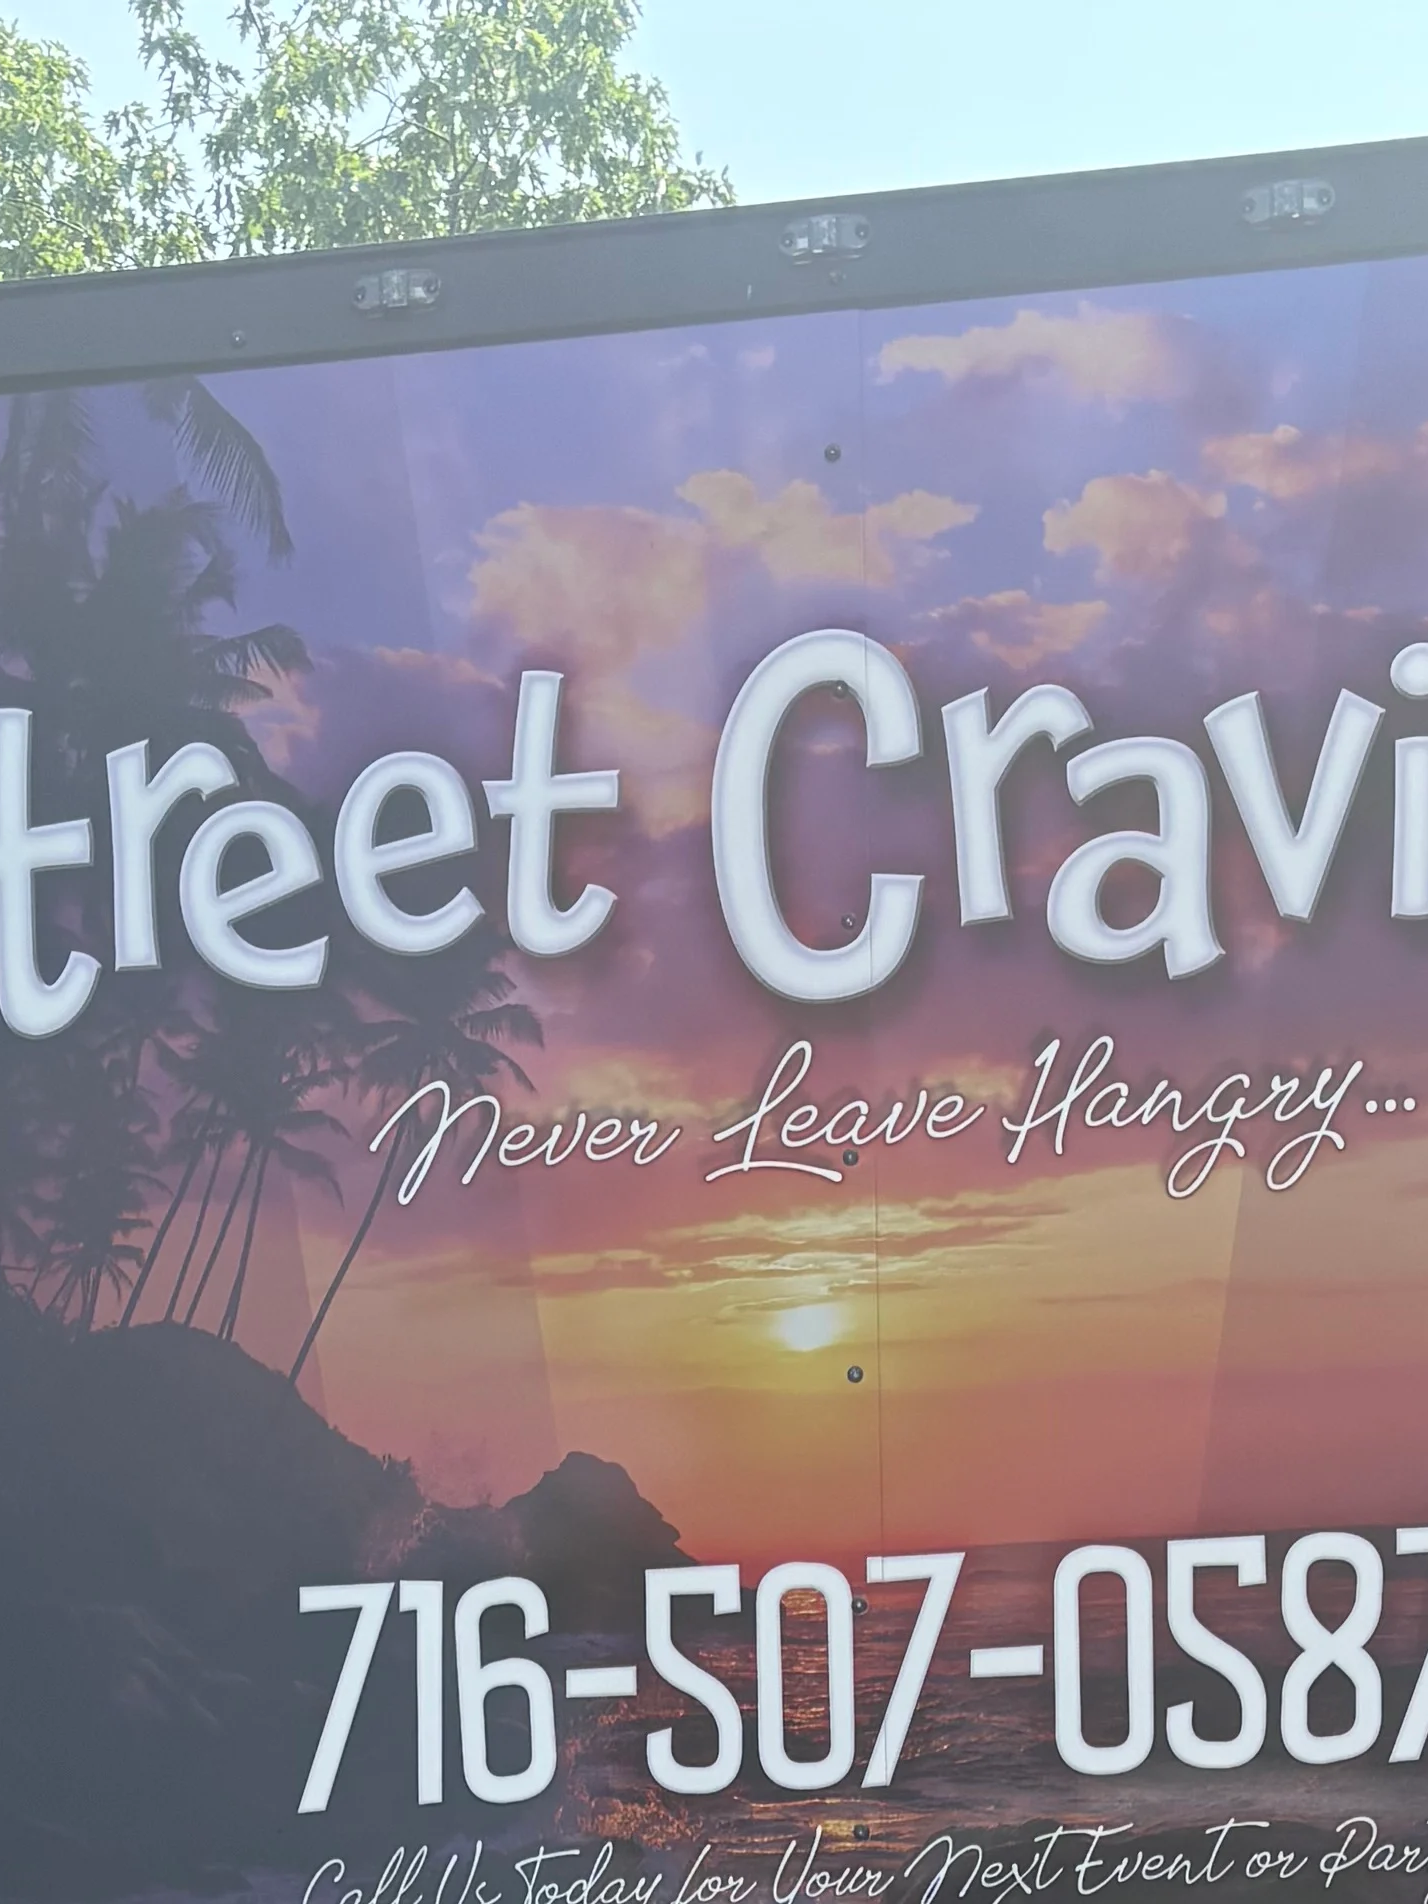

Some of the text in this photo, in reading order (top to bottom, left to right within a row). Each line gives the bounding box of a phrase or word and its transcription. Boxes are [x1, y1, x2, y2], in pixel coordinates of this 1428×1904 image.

[369, 1035, 1418, 1206] Never Leave Hangry...
[1075, 1816, 1270, 1896] Event
[1244, 1845, 1309, 1879] or
